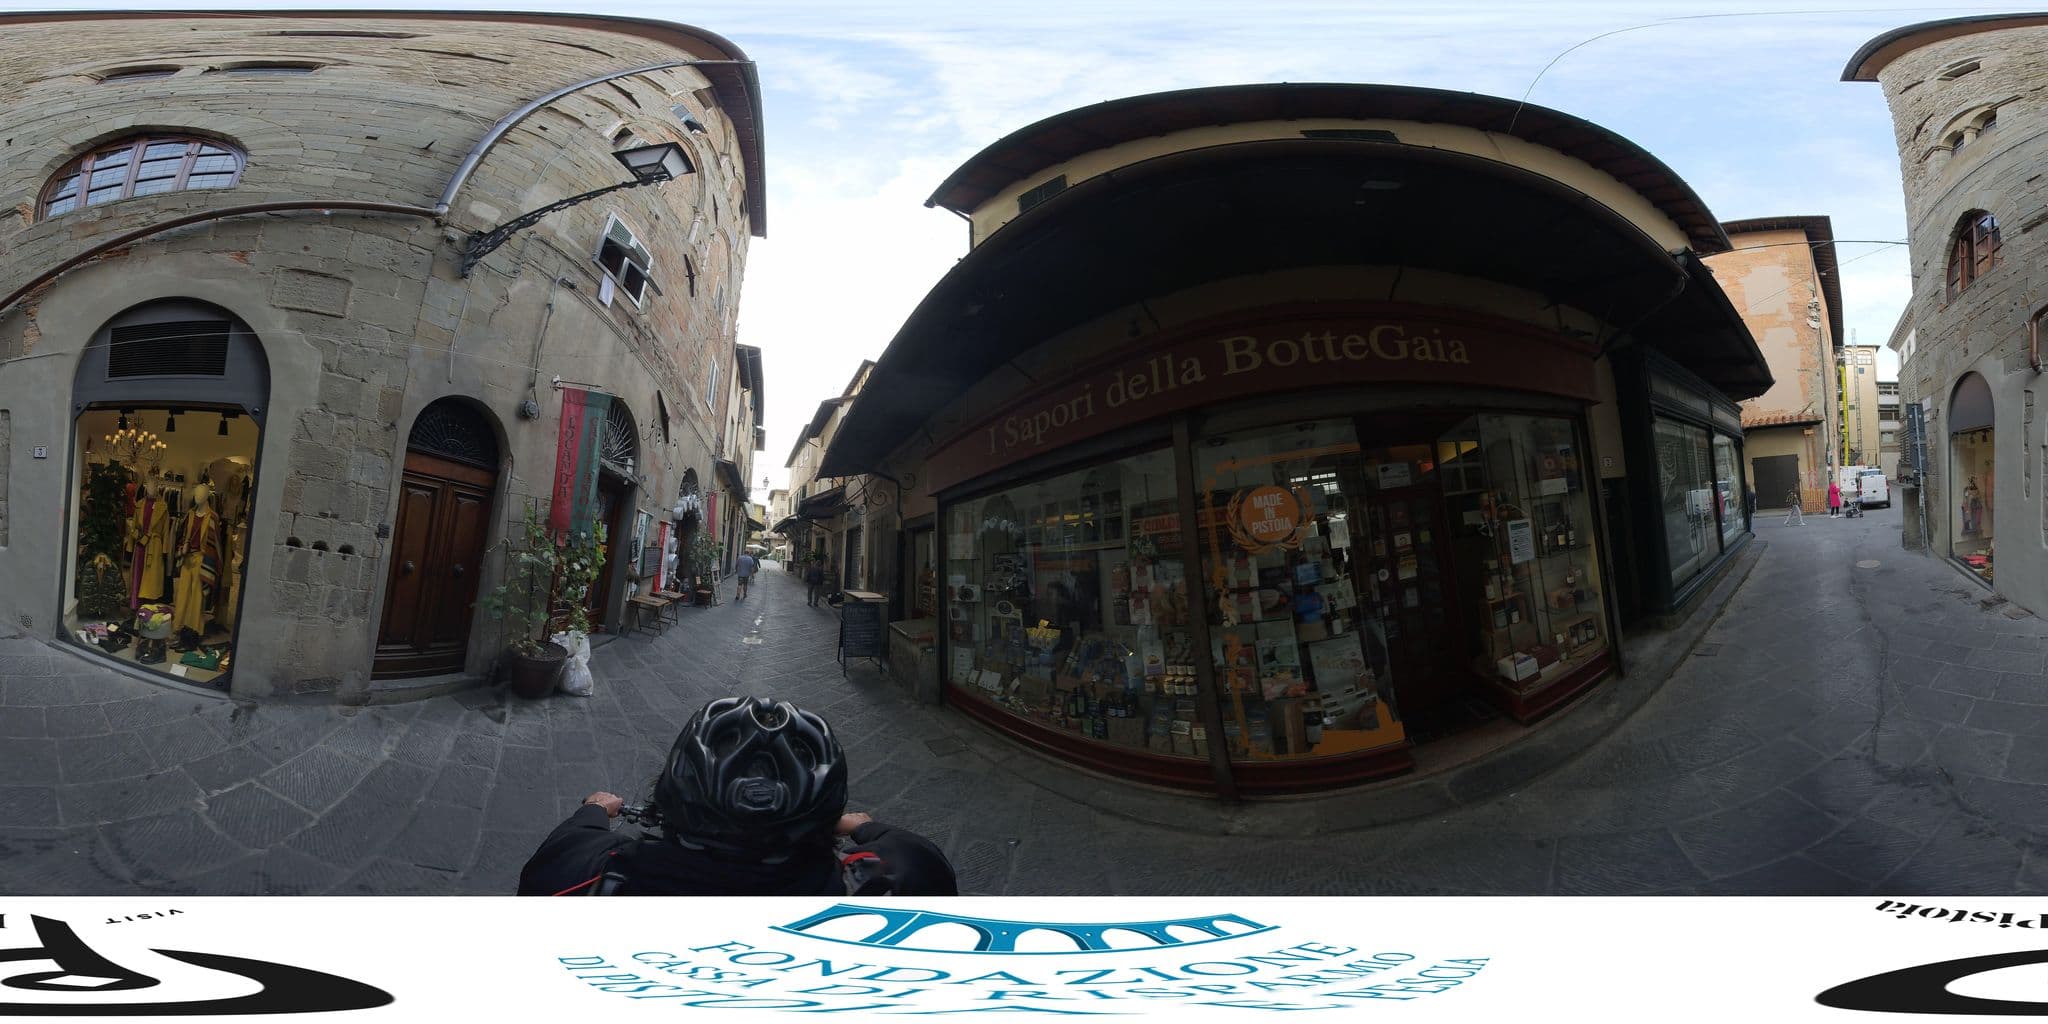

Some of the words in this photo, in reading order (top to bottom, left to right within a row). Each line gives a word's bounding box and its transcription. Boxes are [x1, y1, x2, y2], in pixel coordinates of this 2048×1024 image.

[987, 427, 1001, 456] I
[1003, 384, 1097, 449] Sapori
[1105, 354, 1207, 408] della
[1217, 323, 1471, 377] BotteGaia
[1252, 493, 1284, 509] MADE
[1264, 508, 1276, 520] IN
[1252, 517, 1293, 535] PISTOIA
